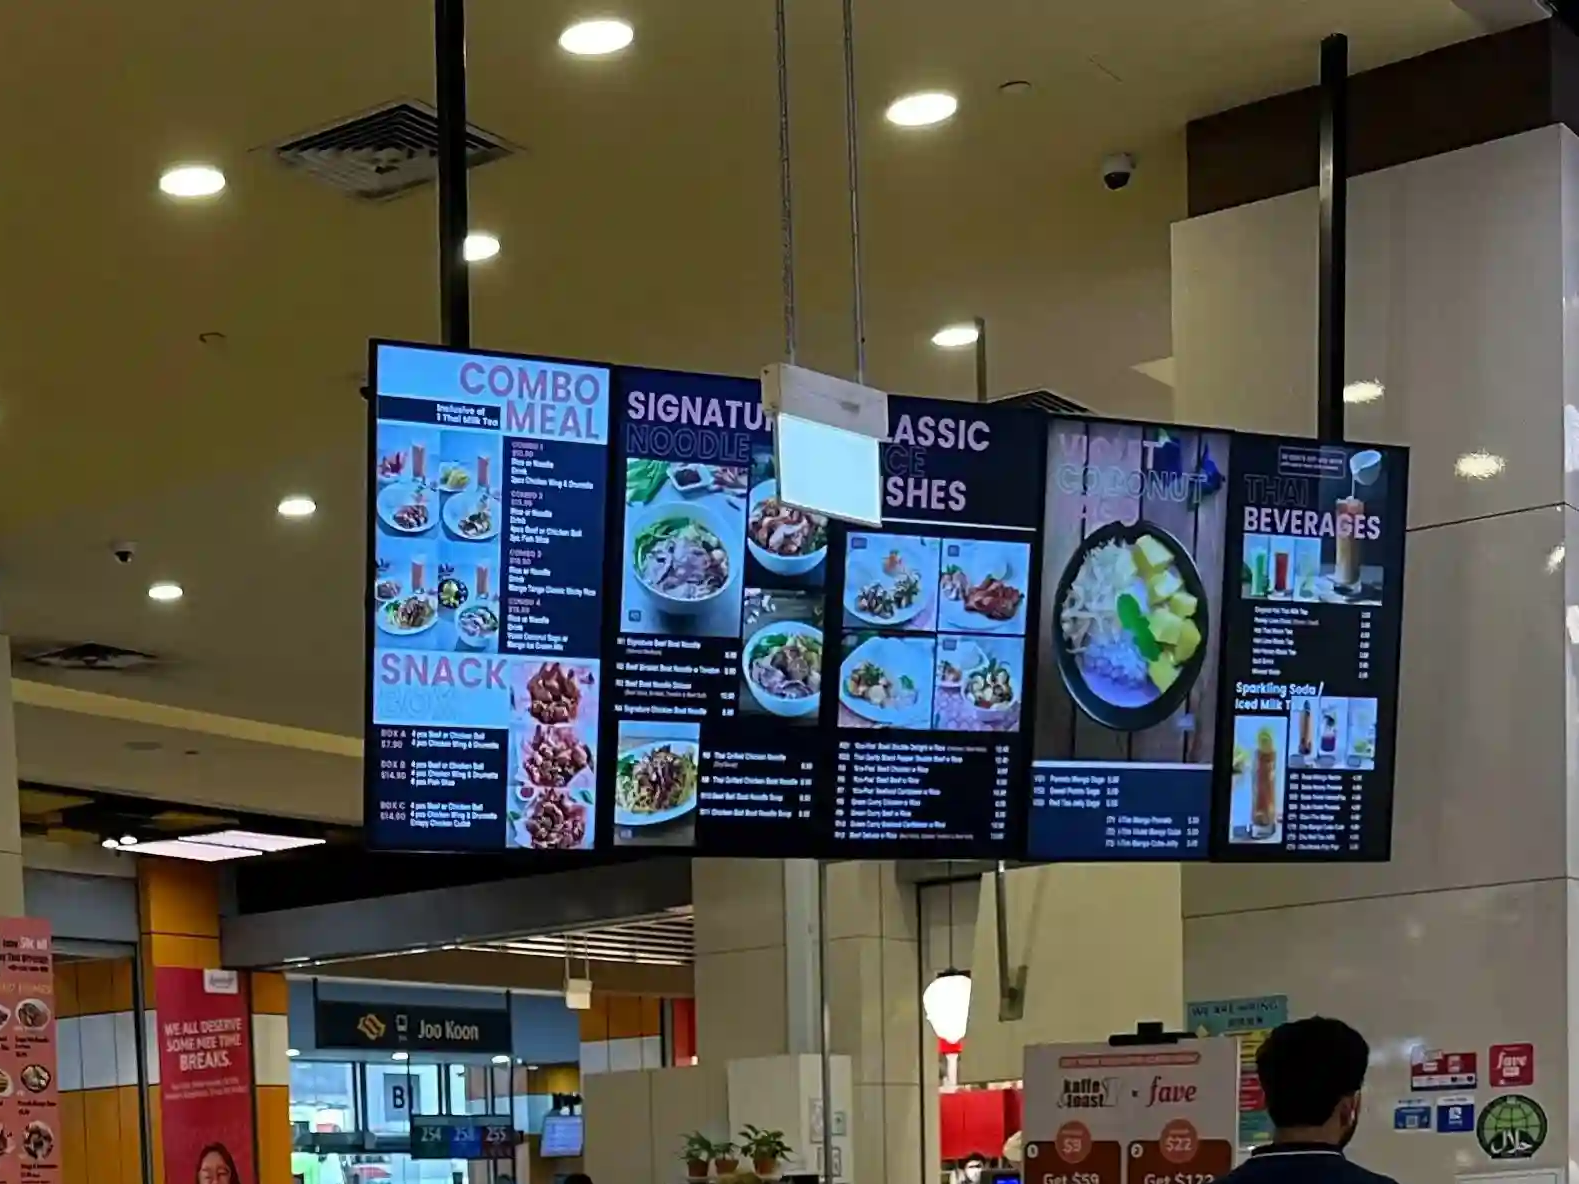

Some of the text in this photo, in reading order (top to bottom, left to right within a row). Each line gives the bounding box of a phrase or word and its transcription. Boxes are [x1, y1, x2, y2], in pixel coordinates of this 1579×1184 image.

[460, 361, 599, 405] COMBO
[506, 399, 599, 439] MEAL
[628, 390, 773, 433] SIGNATU
[888, 414, 990, 451] ASSIC
[886, 476, 967, 511] SHES
[1244, 507, 1380, 540] BEVERAGES
[381, 653, 508, 690] SNACK
[164, 1018, 242, 1036] WE ALL DESERVE
[418, 1018, 479, 1041] Joo Koon
[1496, 1052, 1527, 1069] fave
[392, 1084, 405, 1109] B
[1145, 1075, 1197, 1108] fave
